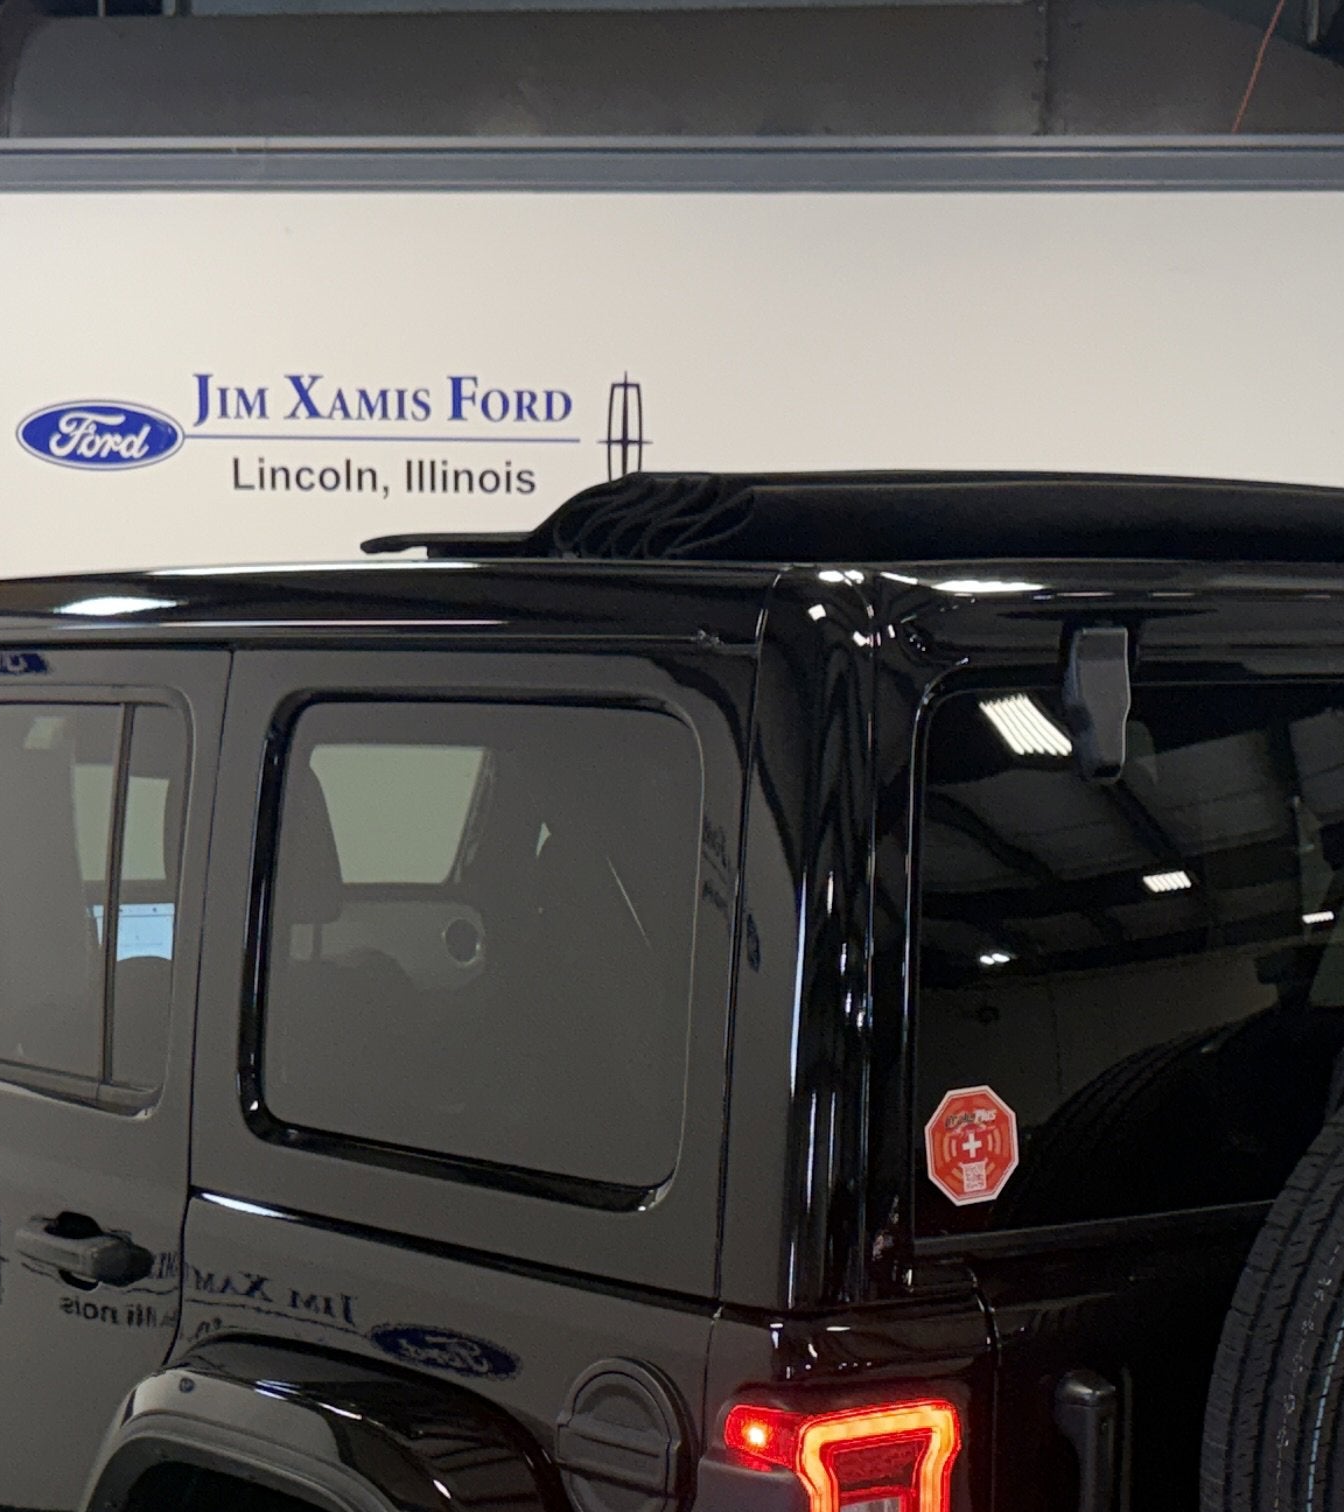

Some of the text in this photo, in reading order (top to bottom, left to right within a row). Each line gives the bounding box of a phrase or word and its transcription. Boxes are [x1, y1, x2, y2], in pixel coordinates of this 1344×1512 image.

[192, 372, 574, 427] JIM XAMIS FORD
[48, 410, 152, 460] Ford
[232, 457, 537, 499] Lincoln, Illinois
